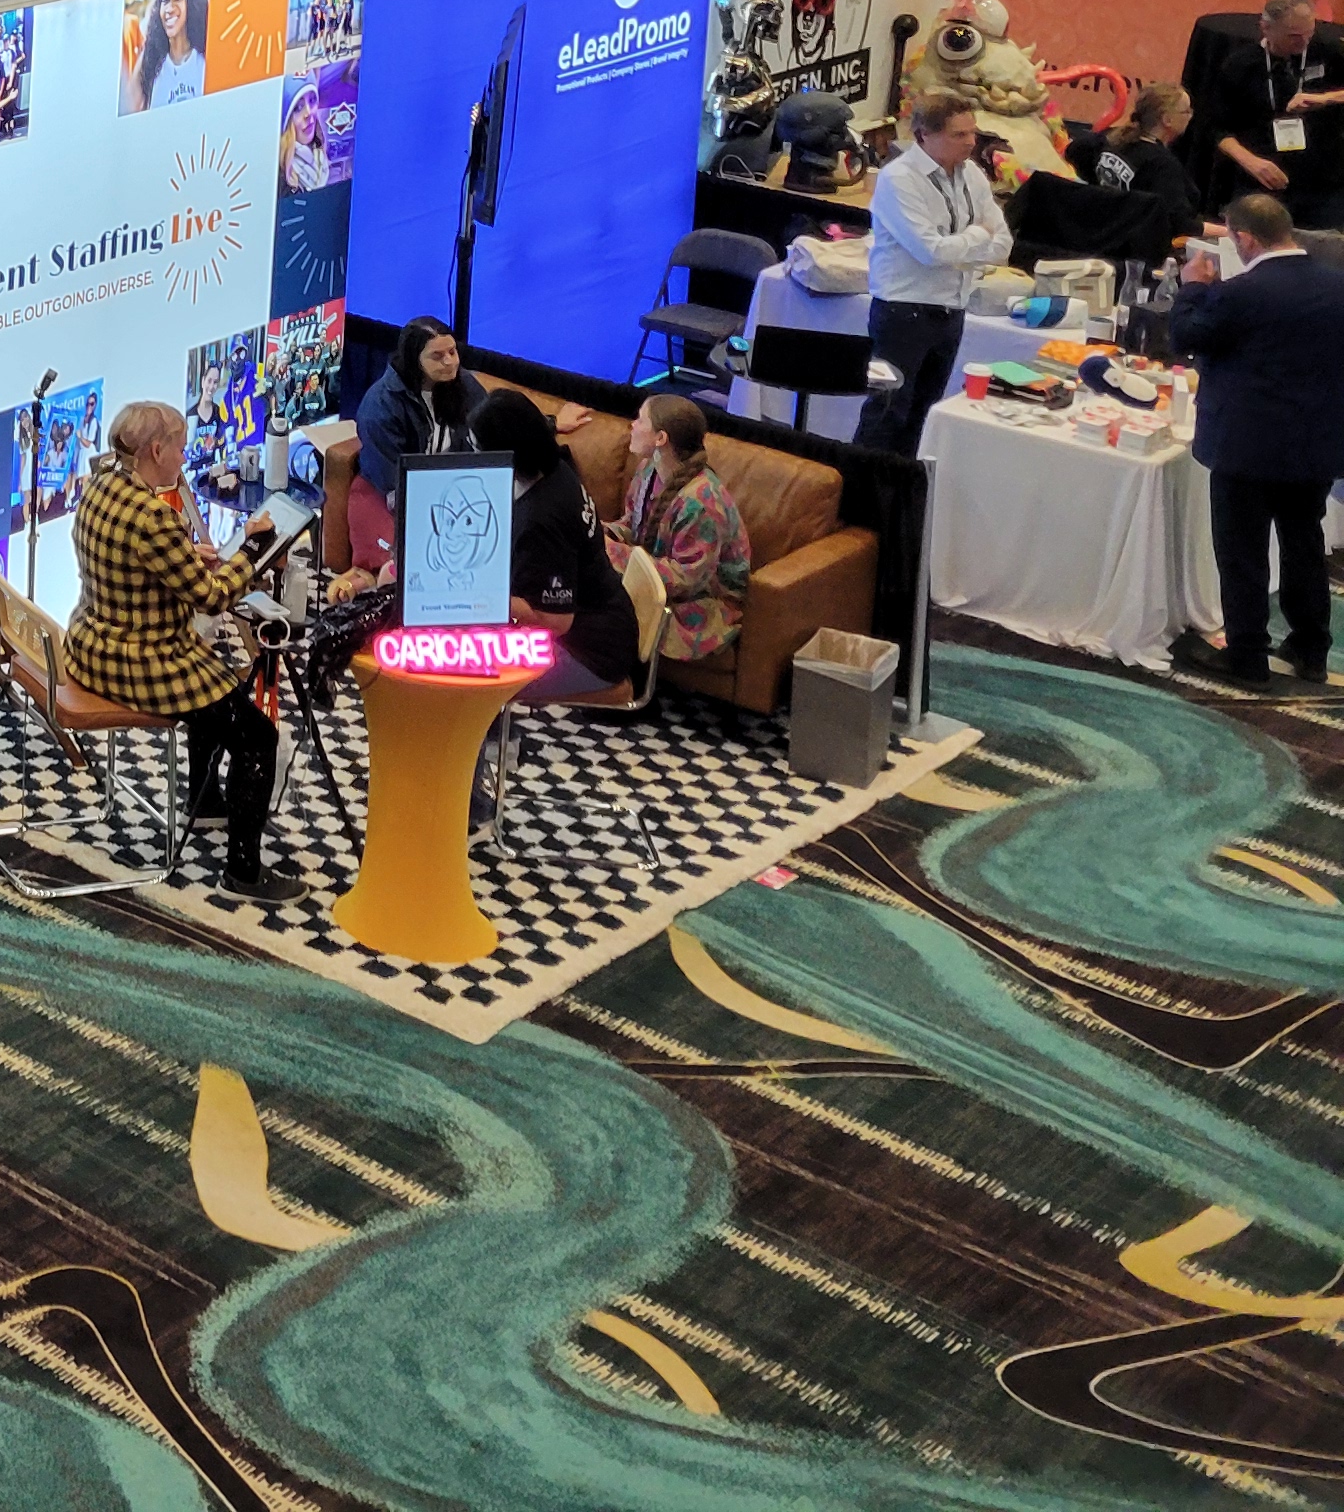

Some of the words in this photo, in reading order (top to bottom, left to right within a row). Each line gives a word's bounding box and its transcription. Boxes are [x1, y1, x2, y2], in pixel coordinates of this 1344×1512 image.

[558, 11, 691, 70] eLeadPromo
[586, 70, 608, 85] Products
[772, 69, 827, 103] ESIGN,
[831, 59, 866, 87] INC.
[49, 219, 166, 277] Staffing
[170, 206, 223, 245] Live
[421, 604, 443, 612] Event
[444, 603, 472, 611] Staffing
[542, 589, 573, 598] ALIGN
[378, 631, 552, 669] CARICATURE
